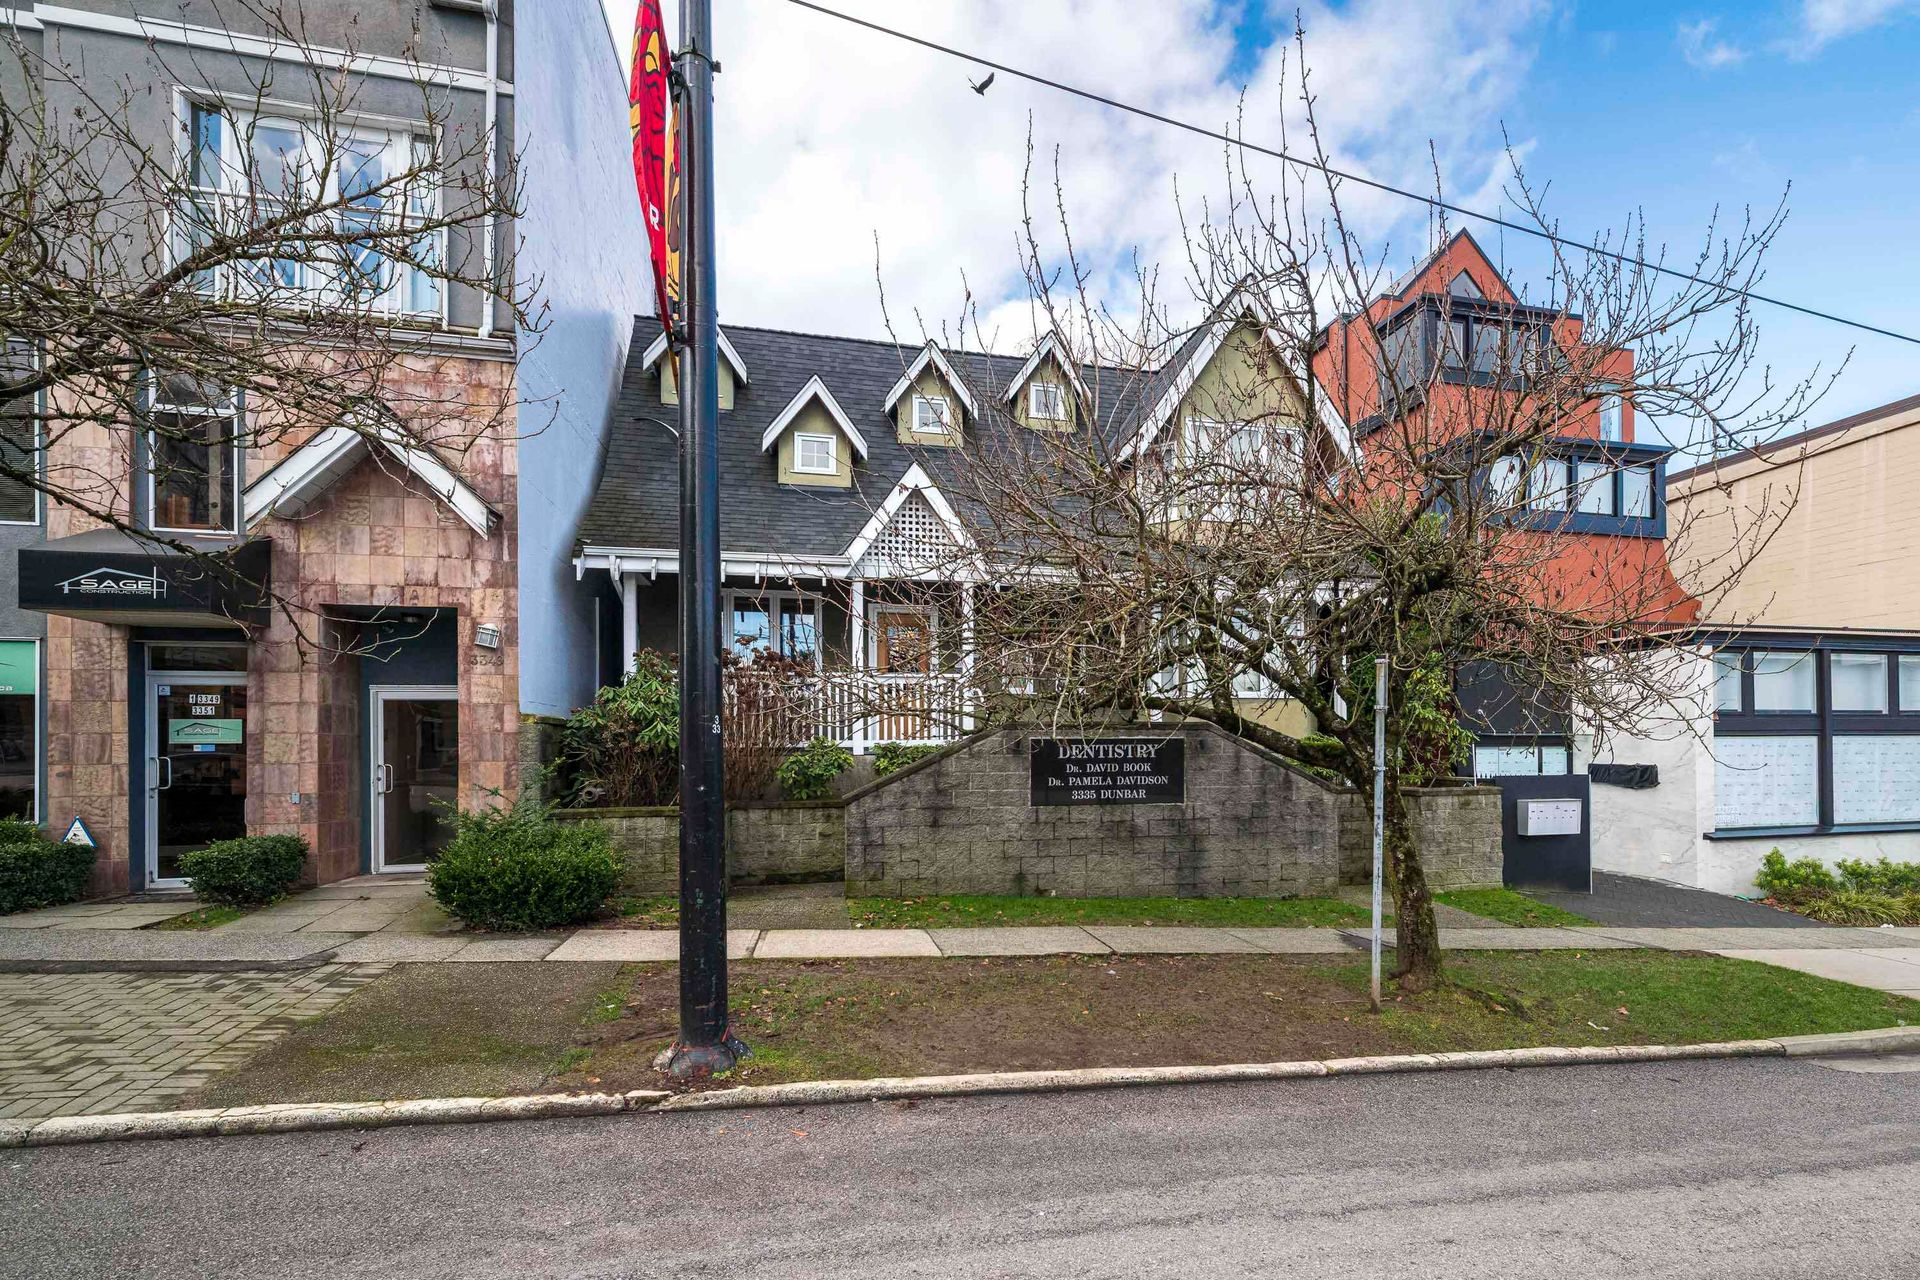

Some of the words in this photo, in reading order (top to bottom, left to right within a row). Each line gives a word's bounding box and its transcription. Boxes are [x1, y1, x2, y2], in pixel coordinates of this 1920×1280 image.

[80, 579, 152, 589] SAGE
[198, 695, 220, 703] 3349
[193, 707, 214, 715] 3351
[714, 715, 720, 725] 3
[1058, 743, 1158, 758] DENTISTRY
[1086, 763, 1119, 772] DAVID
[1123, 763, 1151, 772] BOOK
[1069, 776, 1112, 786] PAMELA
[1117, 776, 1169, 785] DAVIDSON
[1072, 790, 1096, 799] 3335
[1101, 789, 1146, 799] DUNBAR
